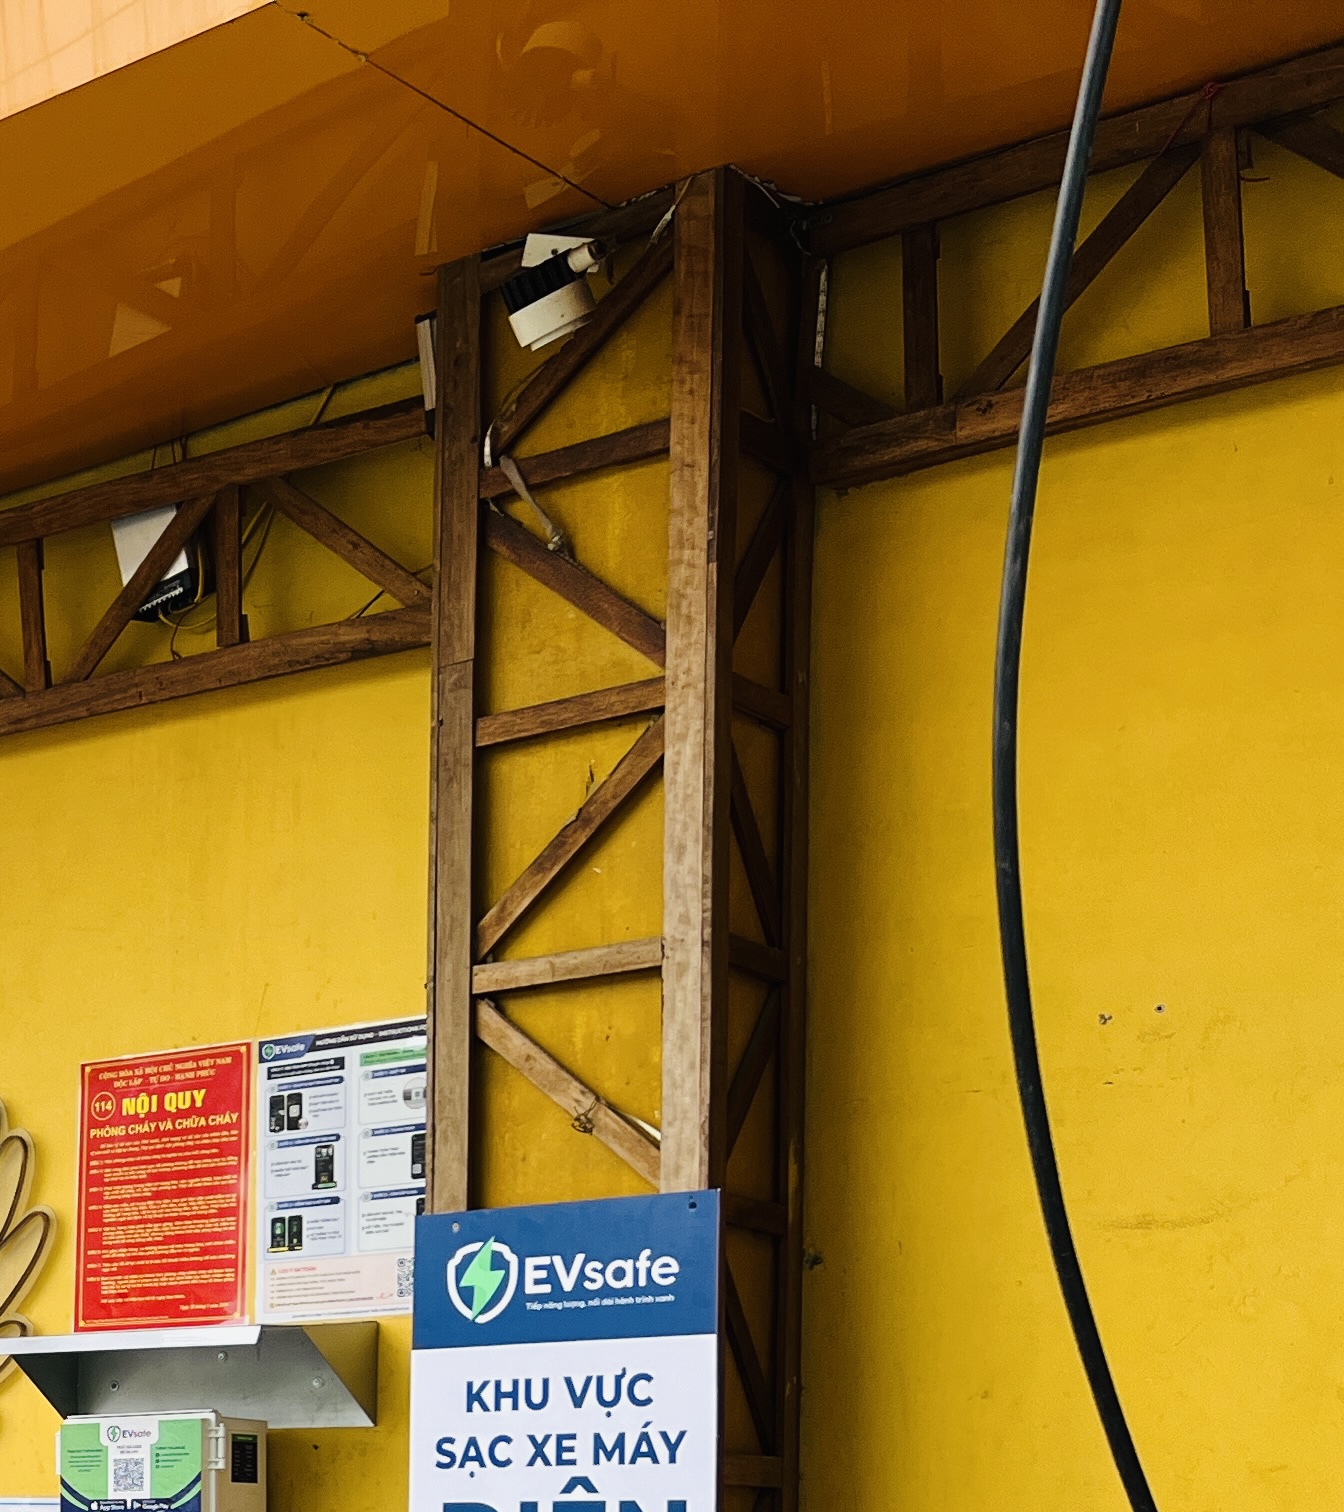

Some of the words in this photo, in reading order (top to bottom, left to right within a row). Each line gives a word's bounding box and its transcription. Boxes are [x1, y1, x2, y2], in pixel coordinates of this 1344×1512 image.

[94, 1100, 113, 1113] 114
[122, 1092, 158, 1118] NỘI
[164, 1088, 207, 1113] QUY
[89, 1123, 126, 1140] PHÒNG
[127, 1119, 157, 1136] CHÁY
[157, 1117, 173, 1132] VÀ
[175, 1113, 207, 1130] CHỮA
[207, 1110, 240, 1126] CHÁY
[524, 1248, 680, 1295] EVsafe
[526, 1300, 543, 1312] Tiếp
[543, 1300, 563, 1311] năng
[466, 1378, 549, 1412] KHU
[563, 1367, 654, 1417] VỰC
[122, 1428, 152, 1439] EVsafe
[435, 1435, 513, 1478] SẠC
[526, 1433, 577, 1467] XE
[593, 1421, 687, 1466] MÁY
